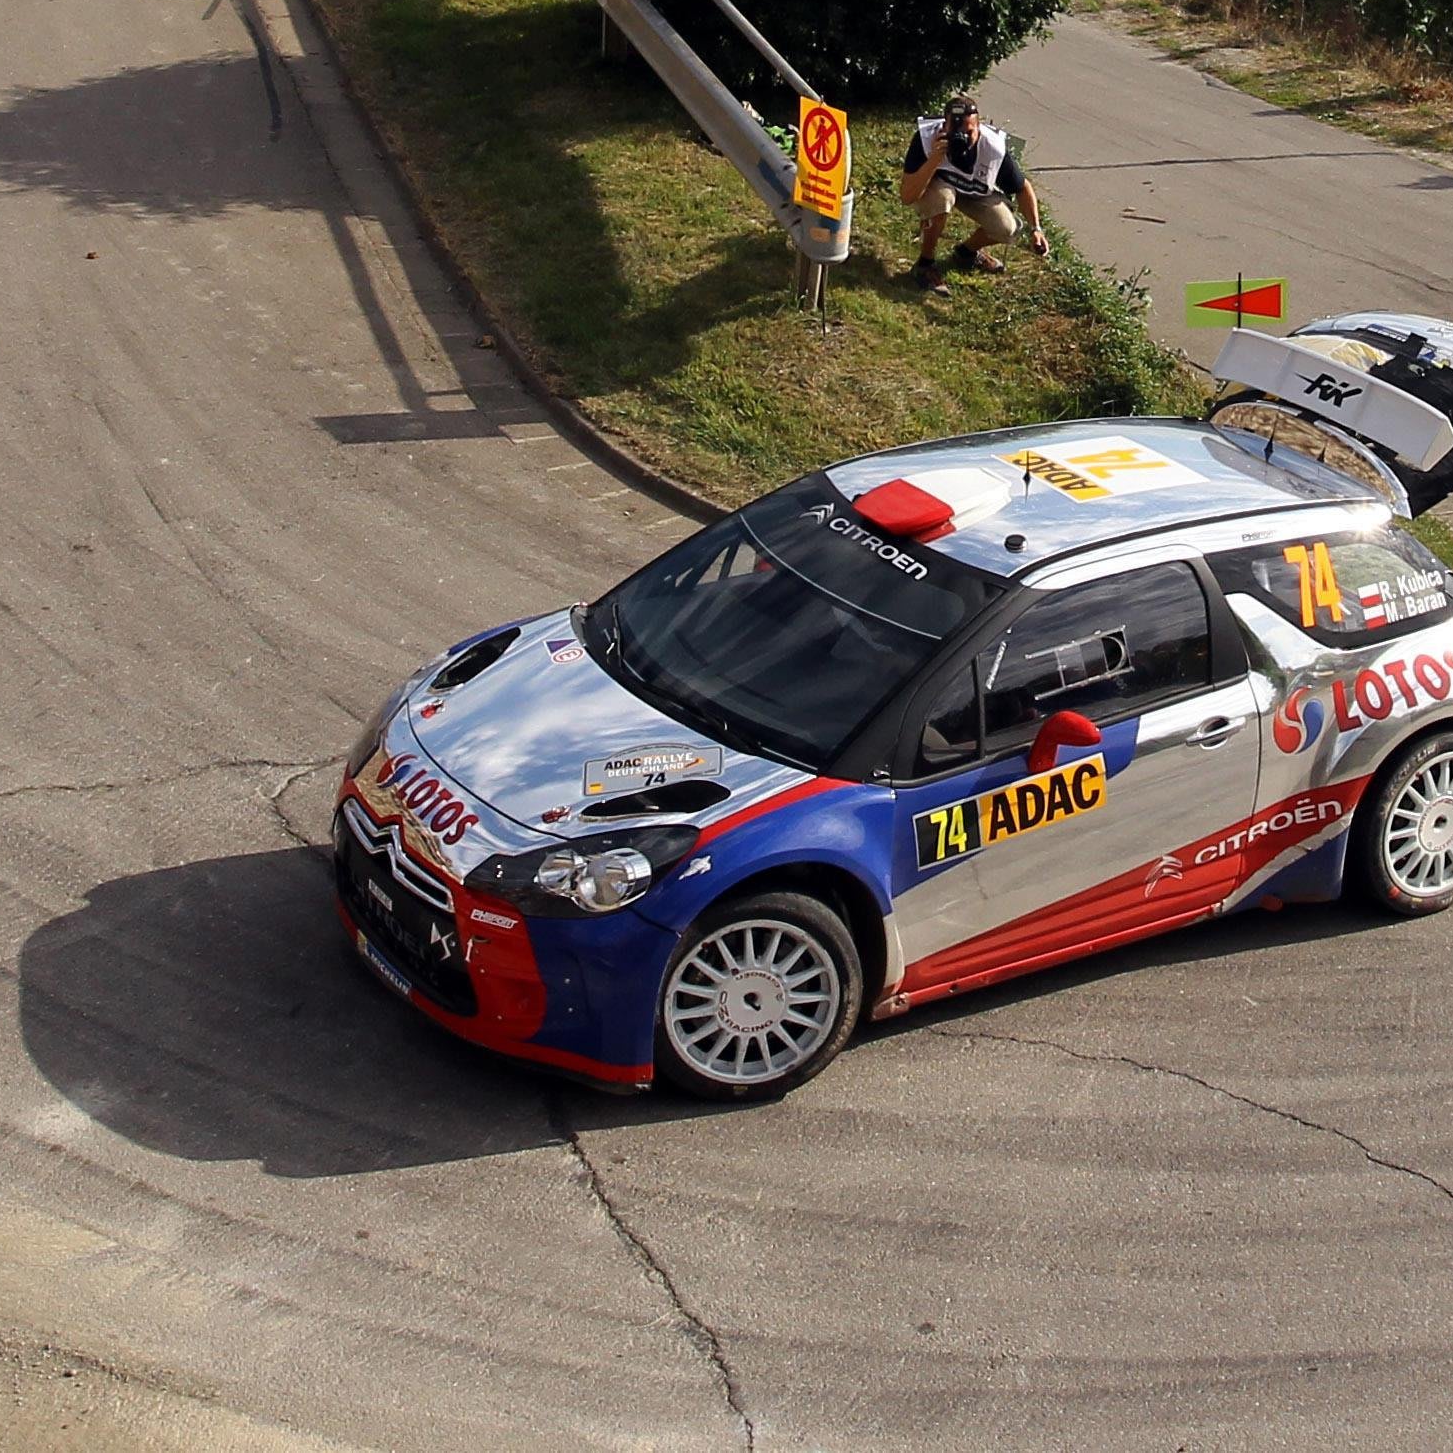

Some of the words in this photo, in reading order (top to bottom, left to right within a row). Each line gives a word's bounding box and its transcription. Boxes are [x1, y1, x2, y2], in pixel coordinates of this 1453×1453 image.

[1012, 455, 1098, 491] ADAC
[1064, 448, 1171, 480] 74
[1283, 541, 1343, 627] 74
[1378, 580, 1397, 602] R.
[1397, 569, 1443, 596] Kubica
[1384, 603, 1404, 623] M.
[1406, 591, 1447, 618] Baran
[604, 757, 642, 771] ADAC
[643, 752, 694, 766] RALLYE
[608, 762, 685, 778] DEUTSCHLAND
[643, 772, 667, 787] 74
[396, 769, 479, 845] LOTOS
[930, 804, 967, 860] 74
[989, 763, 1100, 841] ADAC
[1194, 798, 1342, 865] CITROËN
[367, 951, 409, 995] MICHELIN
[726, 1019, 773, 1033] RACING
